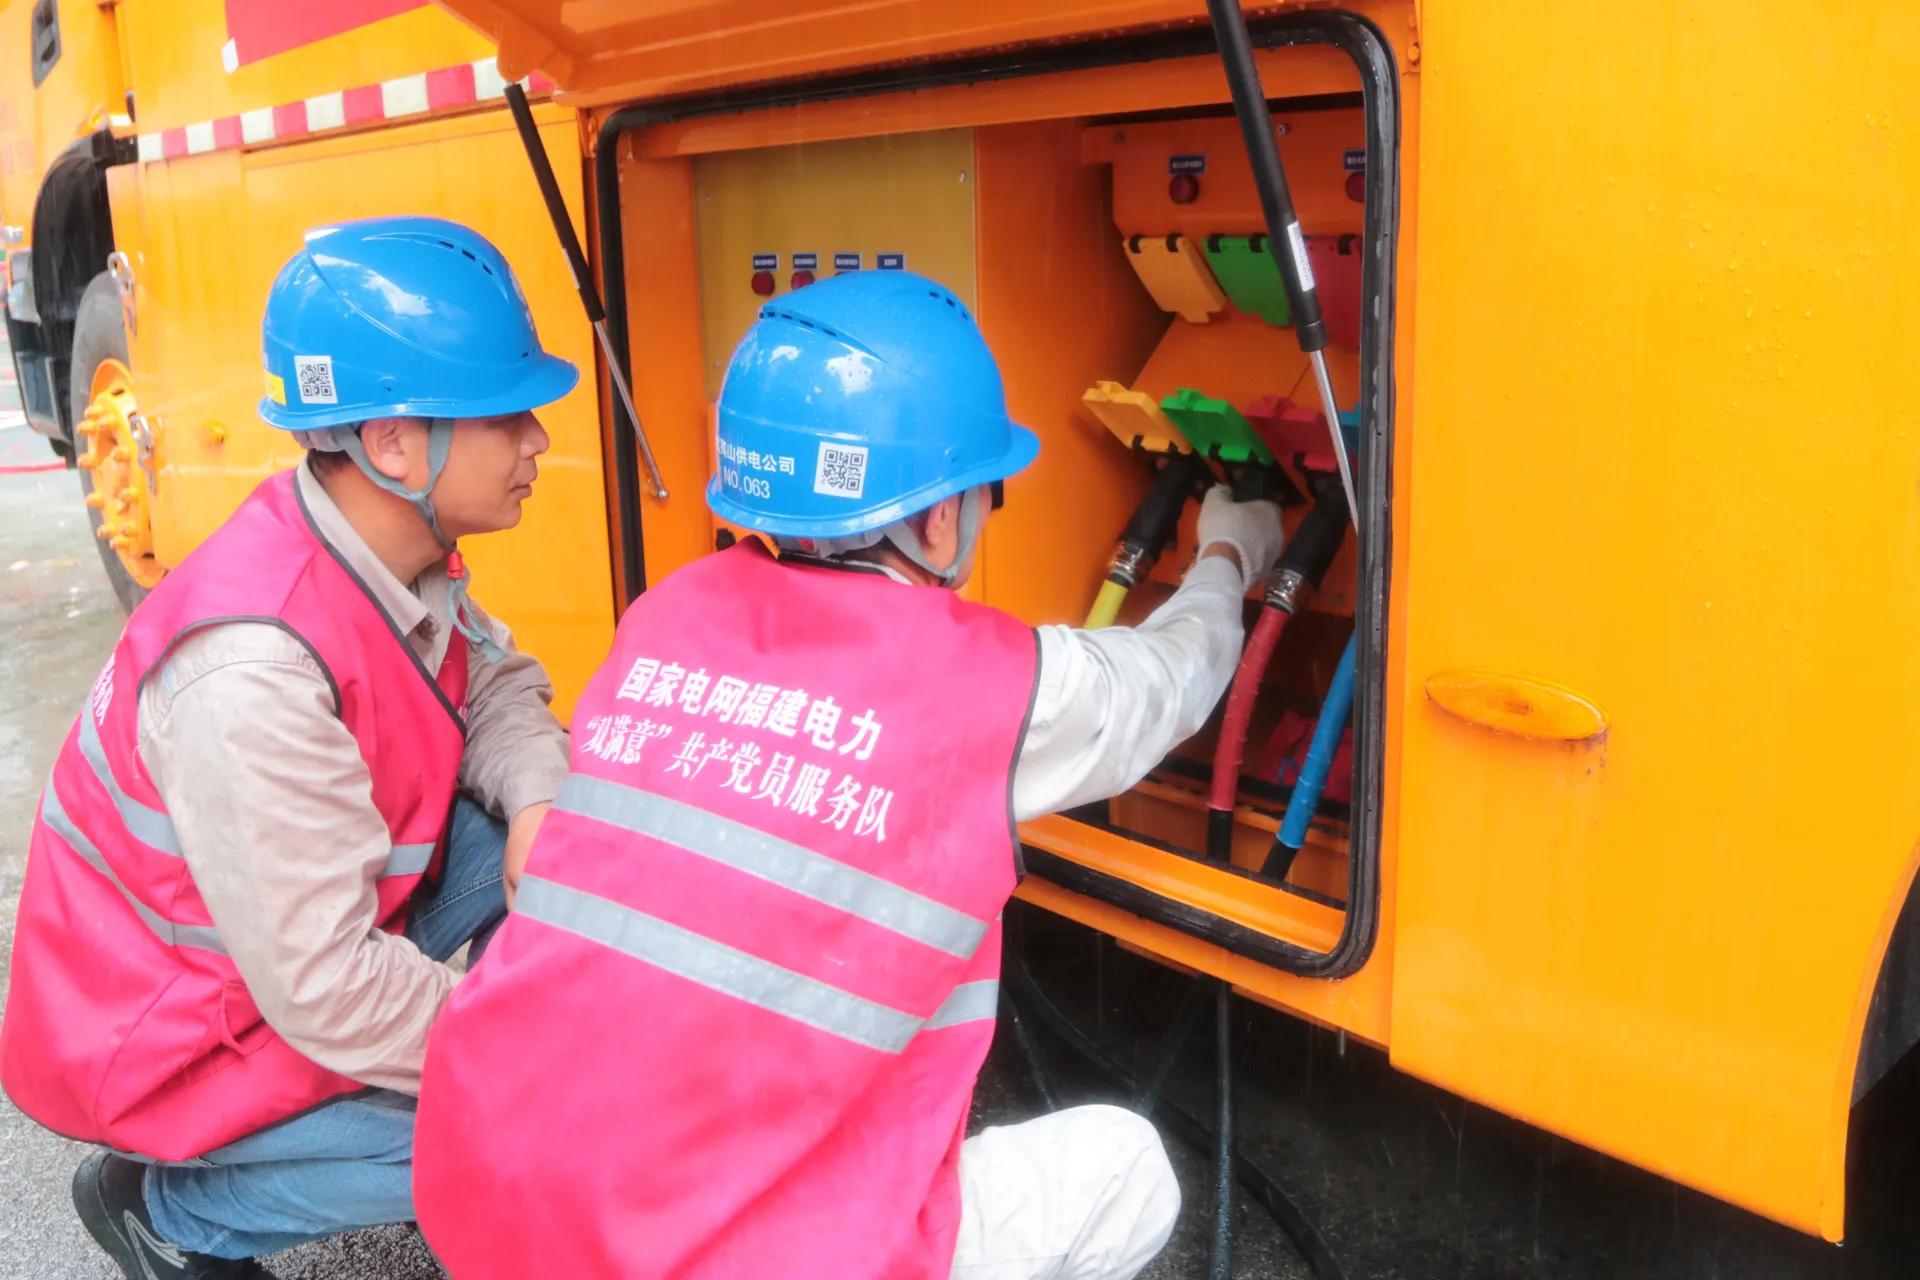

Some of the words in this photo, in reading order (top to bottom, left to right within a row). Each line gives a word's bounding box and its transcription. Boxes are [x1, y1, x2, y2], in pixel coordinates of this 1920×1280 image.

[616, 657, 883, 762] 国家电网福建电力
